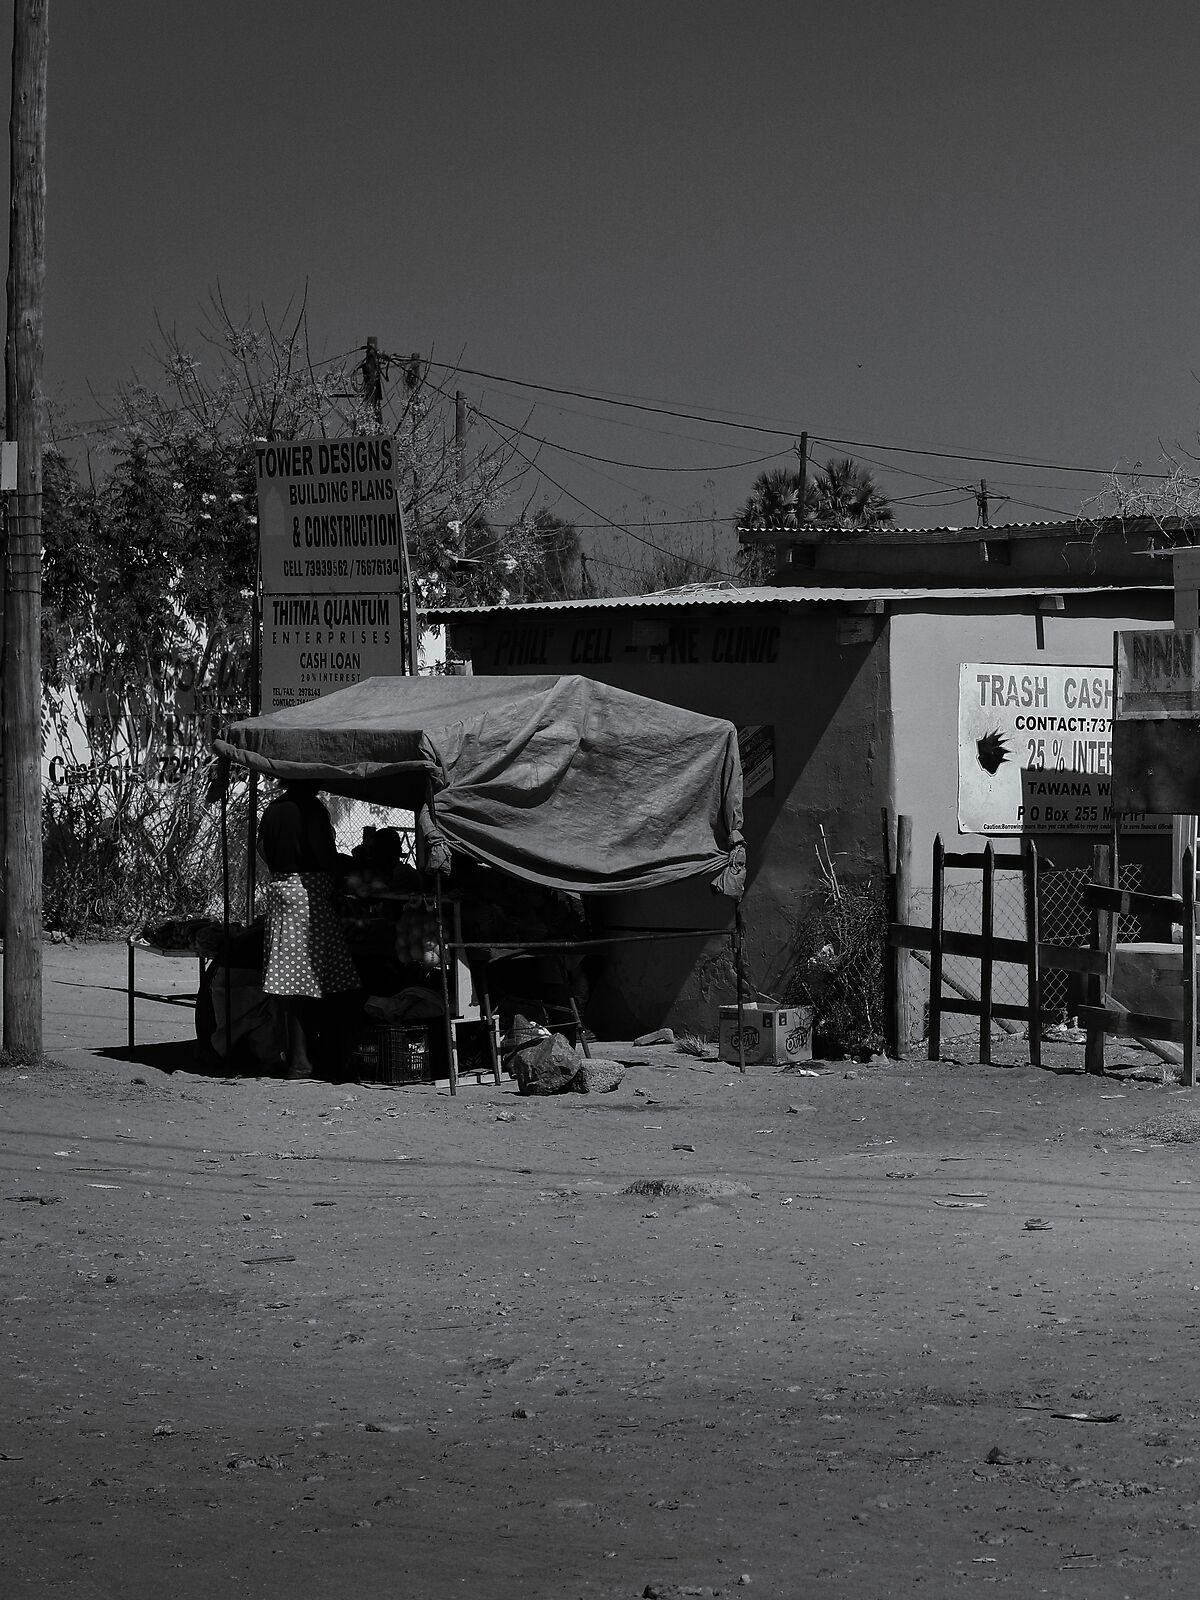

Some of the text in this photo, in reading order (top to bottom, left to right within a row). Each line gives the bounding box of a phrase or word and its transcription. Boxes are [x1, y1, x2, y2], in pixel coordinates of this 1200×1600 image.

[255, 439, 392, 478] TOWER DESIGNS
[289, 479, 394, 505] BUILDING PLANS
[293, 513, 397, 548] & CONSTRUCTION
[284, 560, 303, 576] CELL
[272, 600, 390, 629] THITMA QUANTUM
[272, 631, 390, 644] ENTERPRISES
[570, 628, 612, 664] CELL
[712, 626, 780, 663] CLINIC
[300, 653, 360, 669] CASH LOAN
[320, 673, 360, 682] INTEREST
[976, 674, 1048, 708] TRASH
[1028, 739, 1045, 773] 25
[1052, 740, 1065, 774] %
[1028, 782, 1091, 796] TAWANA
[1017, 806, 1025, 822] P
[1030, 806, 1040, 821] O
[1045, 806, 1069, 821] Box
[1075, 807, 1098, 821] 255
